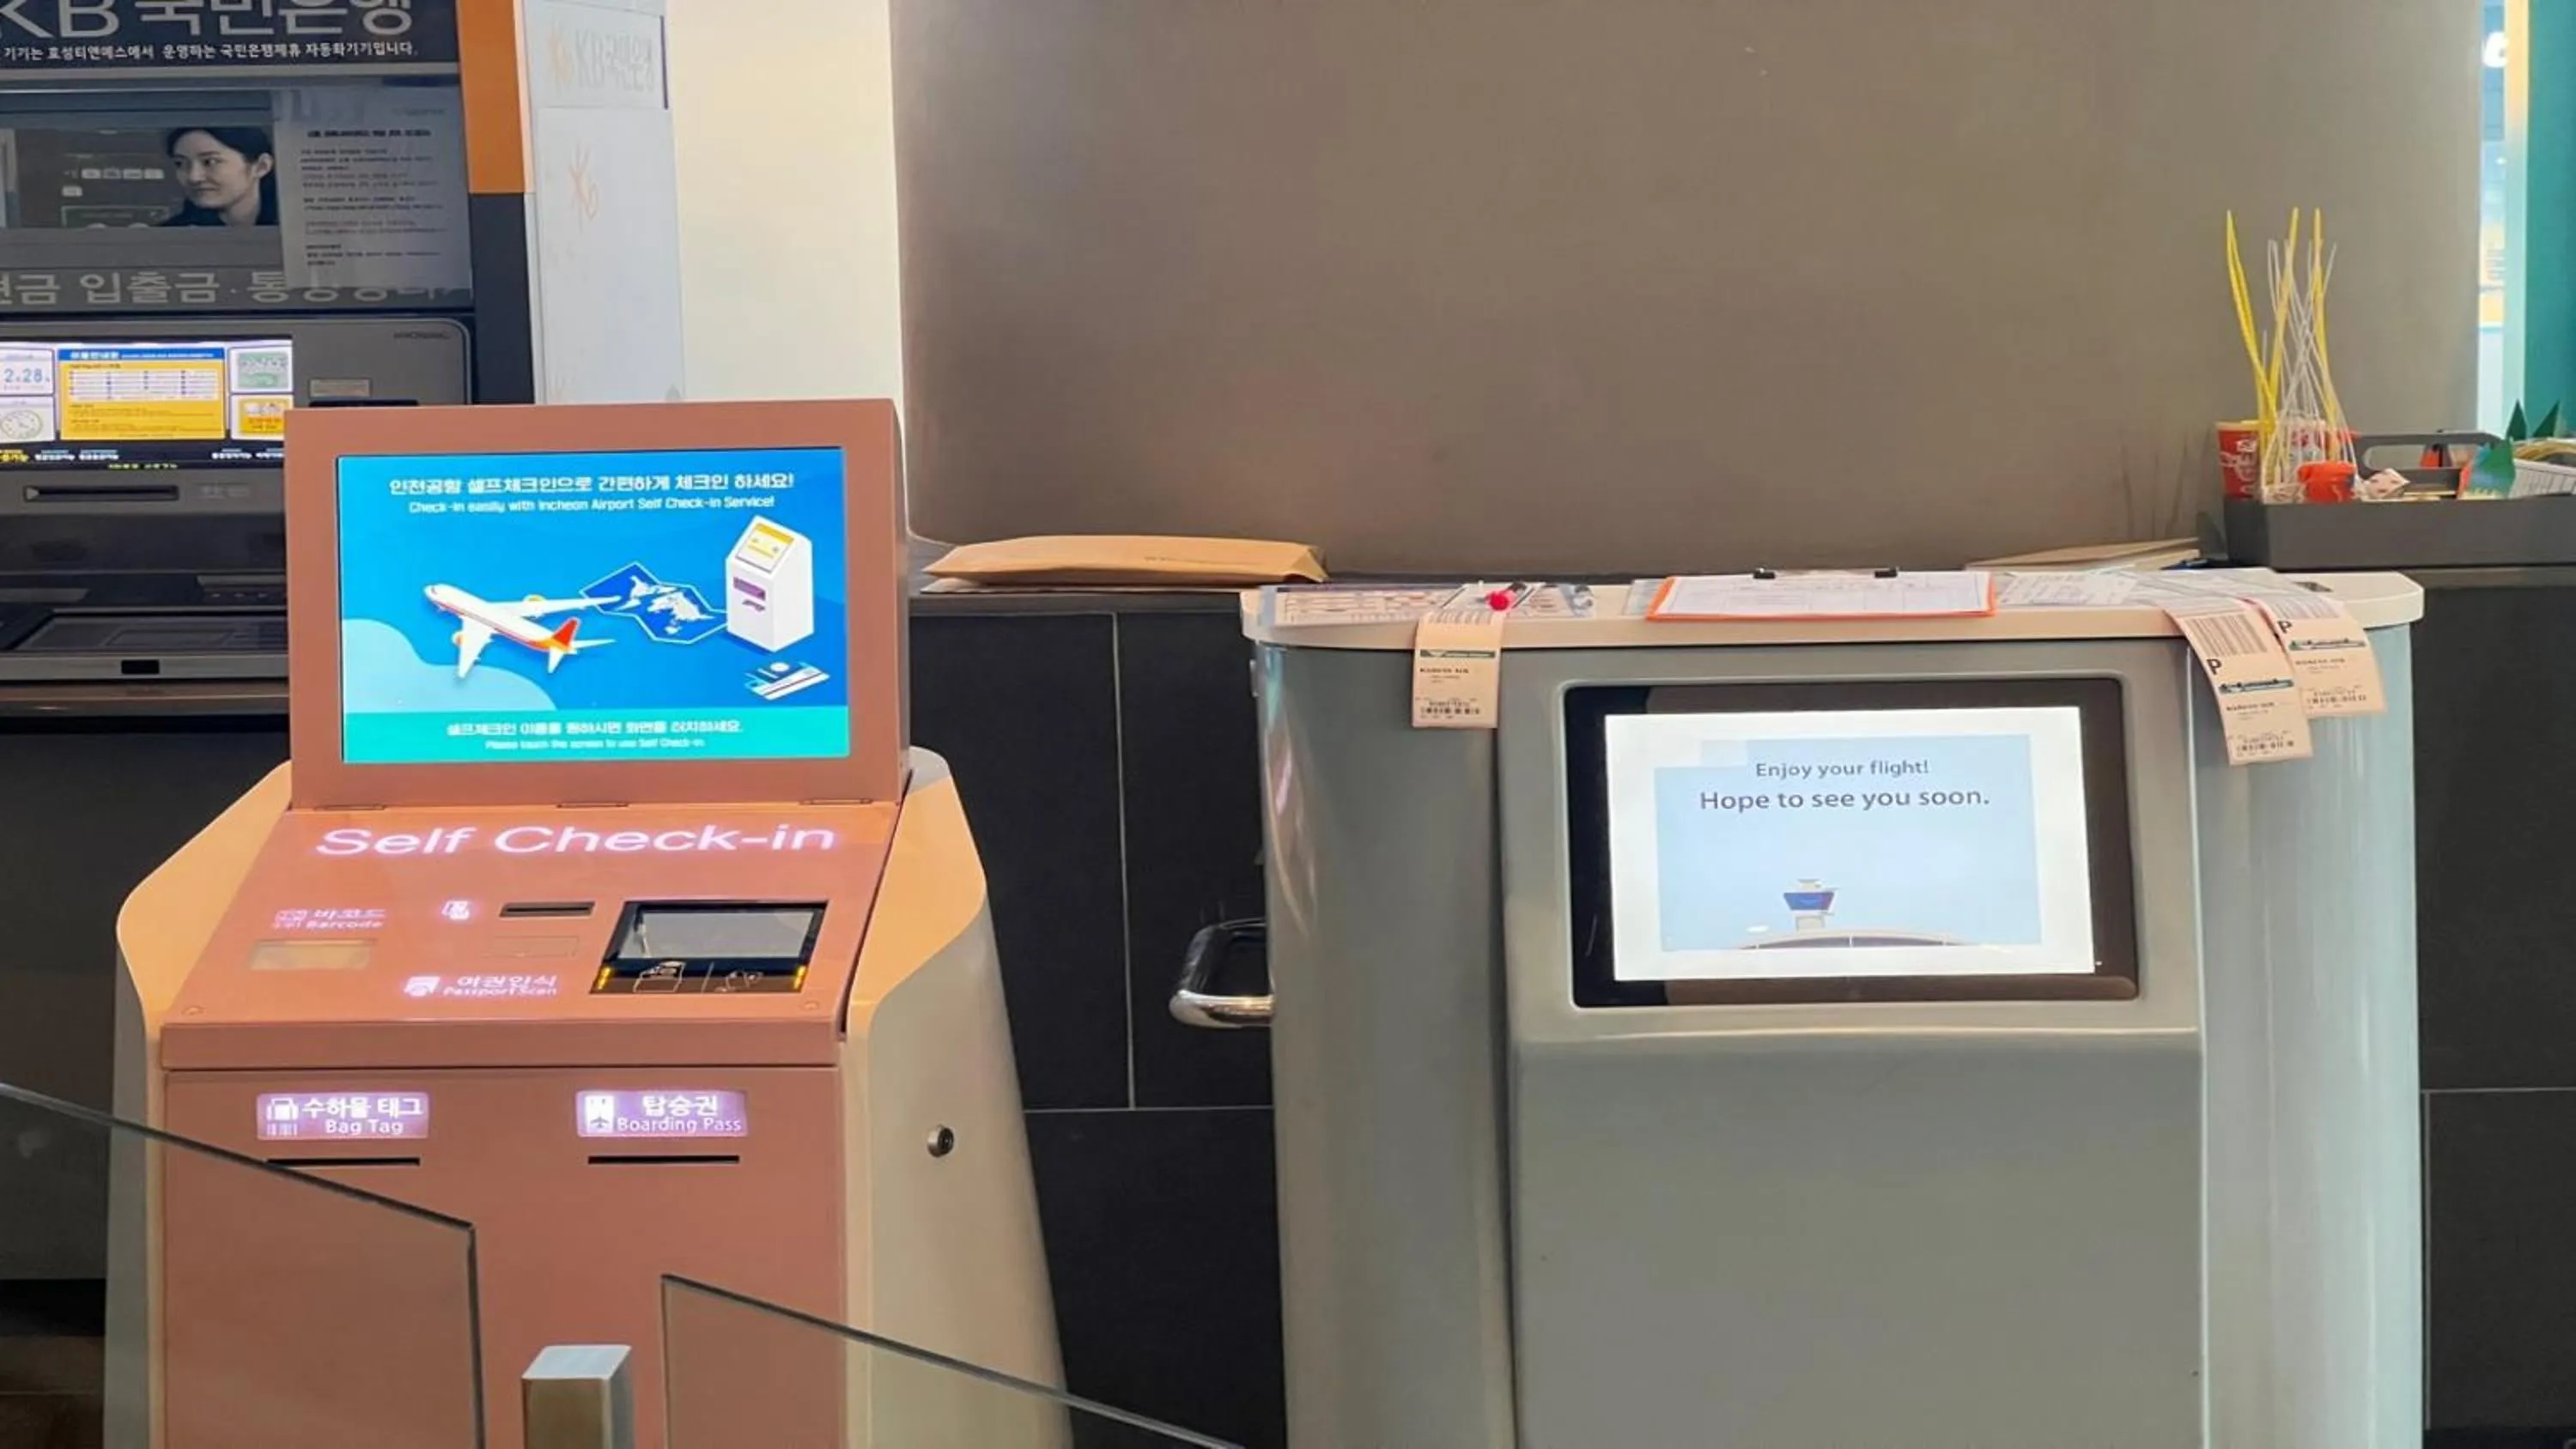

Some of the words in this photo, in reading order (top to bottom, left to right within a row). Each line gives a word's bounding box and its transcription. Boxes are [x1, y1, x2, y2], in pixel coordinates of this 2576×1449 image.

[3, 45, 43, 61] 기기는
[162, 43, 215, 59] 운영하는
[0, 272, 61, 305] 금
[80, 271, 220, 303] 입출금
[390, 478, 461, 495] 인천공항
[468, 476, 592, 494] 셀프체크인으로
[598, 475, 671, 492] 간편하게
[675, 473, 729, 490] 체크인
[734, 472, 794, 488] 하세요!
[508, 501, 535, 512] with
[538, 500, 588, 511] Incheon
[592, 498, 633, 510] Airport
[638, 497, 661, 509] Self
[665, 496, 720, 508] Check-in
[2278, 621, 2292, 634] P
[2207, 658, 2221, 675] P
[1756, 762, 1813, 780] Enjoy
[1818, 764, 1863, 779] your
[1870, 759, 1929, 778] flight!
[1700, 791, 1770, 814] Hope
[1777, 793, 1804, 808] to
[1812, 793, 1855, 808] see
[1862, 791, 1911, 811] you
[1919, 789, 1990, 806] soon.
[316, 828, 476, 855] Self
[494, 823, 837, 852] Check-in
[314, 908, 386, 919] 바코드
[307, 920, 383, 930] Barcode
[302, 1097, 371, 1119] 수하물
[377, 1097, 423, 1119] 태그
[642, 1095, 719, 1116] 탑승권
[325, 1119, 361, 1135] Bag
[368, 1119, 404, 1135] Tag
[617, 1117, 697, 1134] Boarding
[703, 1118, 742, 1131] Pass
